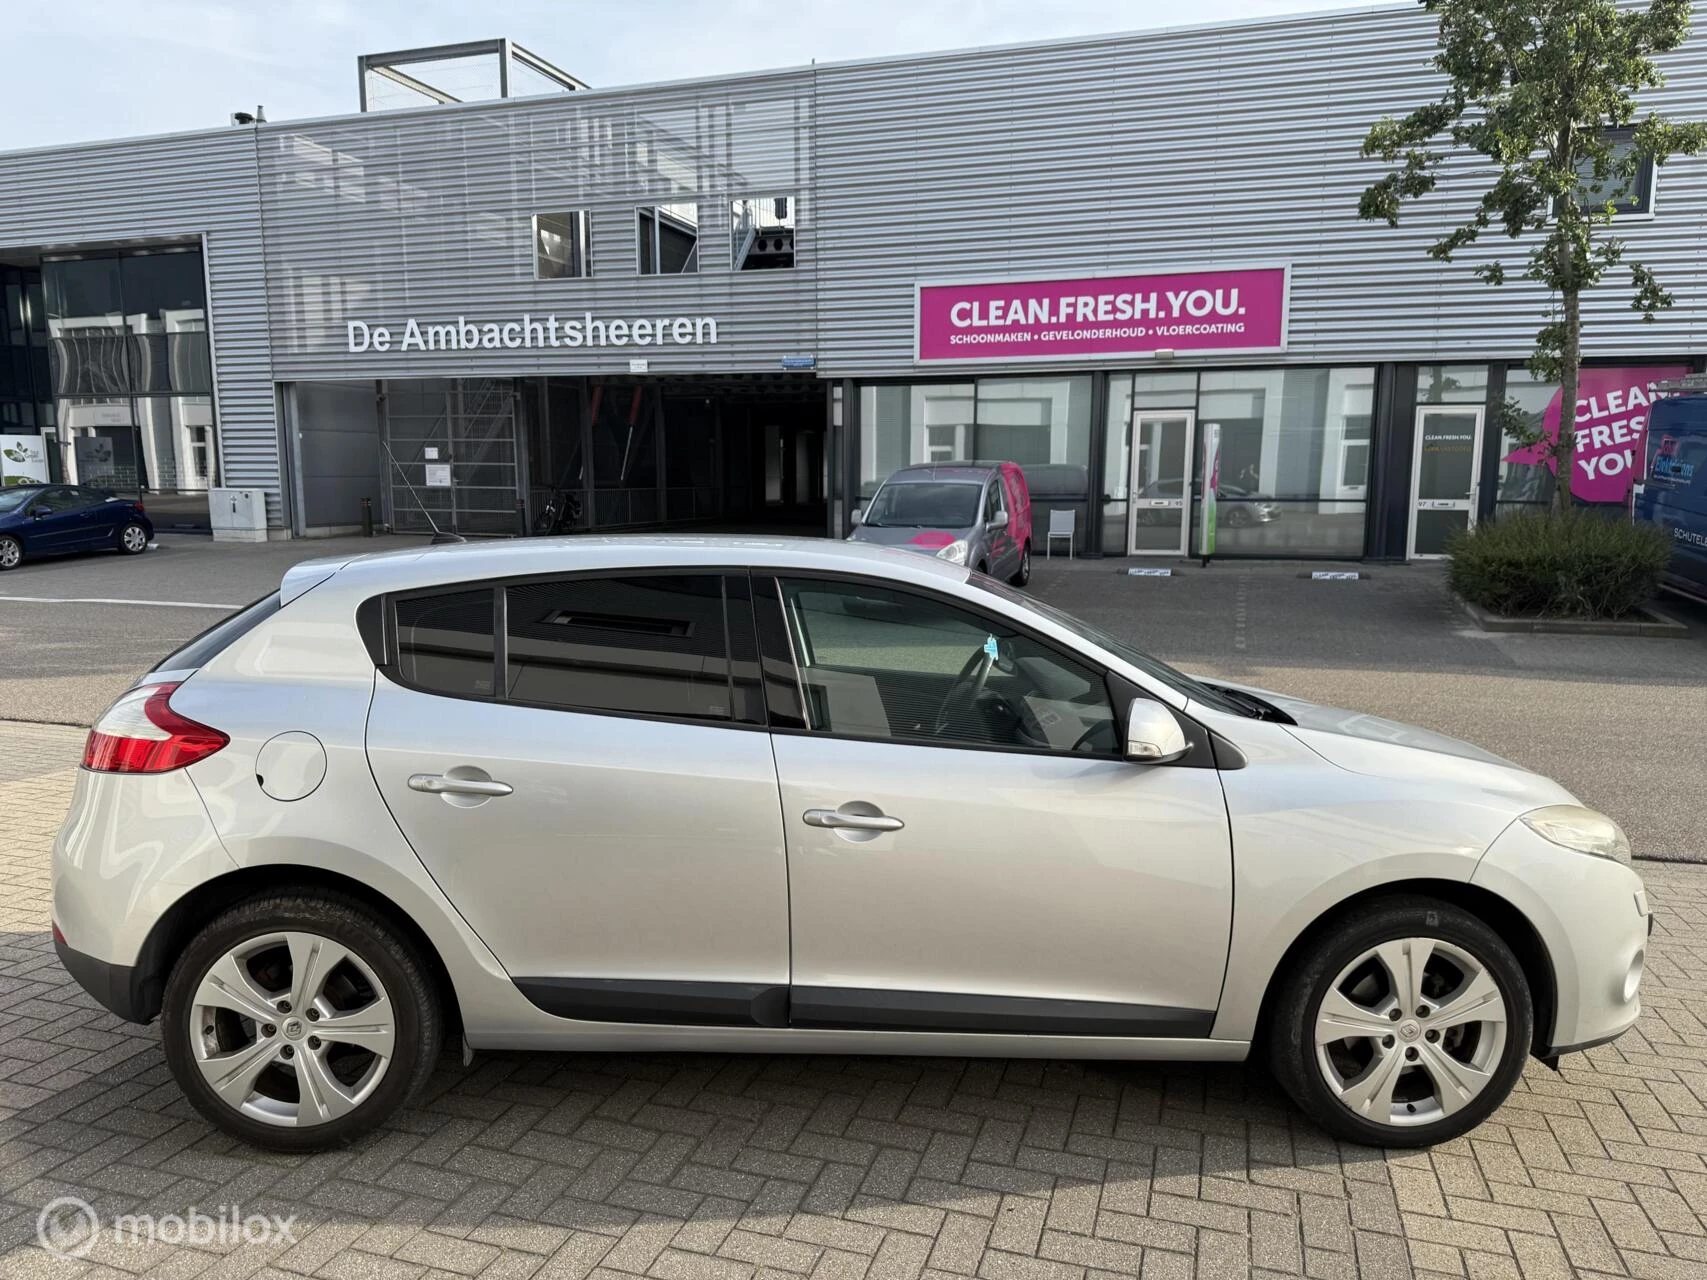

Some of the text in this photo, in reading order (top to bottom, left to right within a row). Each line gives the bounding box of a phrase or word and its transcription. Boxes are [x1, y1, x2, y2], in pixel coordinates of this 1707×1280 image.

[950, 288, 1246, 327] CLEAN.FRESH.YOU.
[347, 312, 718, 352] De Ambachtsheeren
[950, 322, 1245, 345] SCHOONMAKEN GEVELONDERHOUD VLOERCOATING
